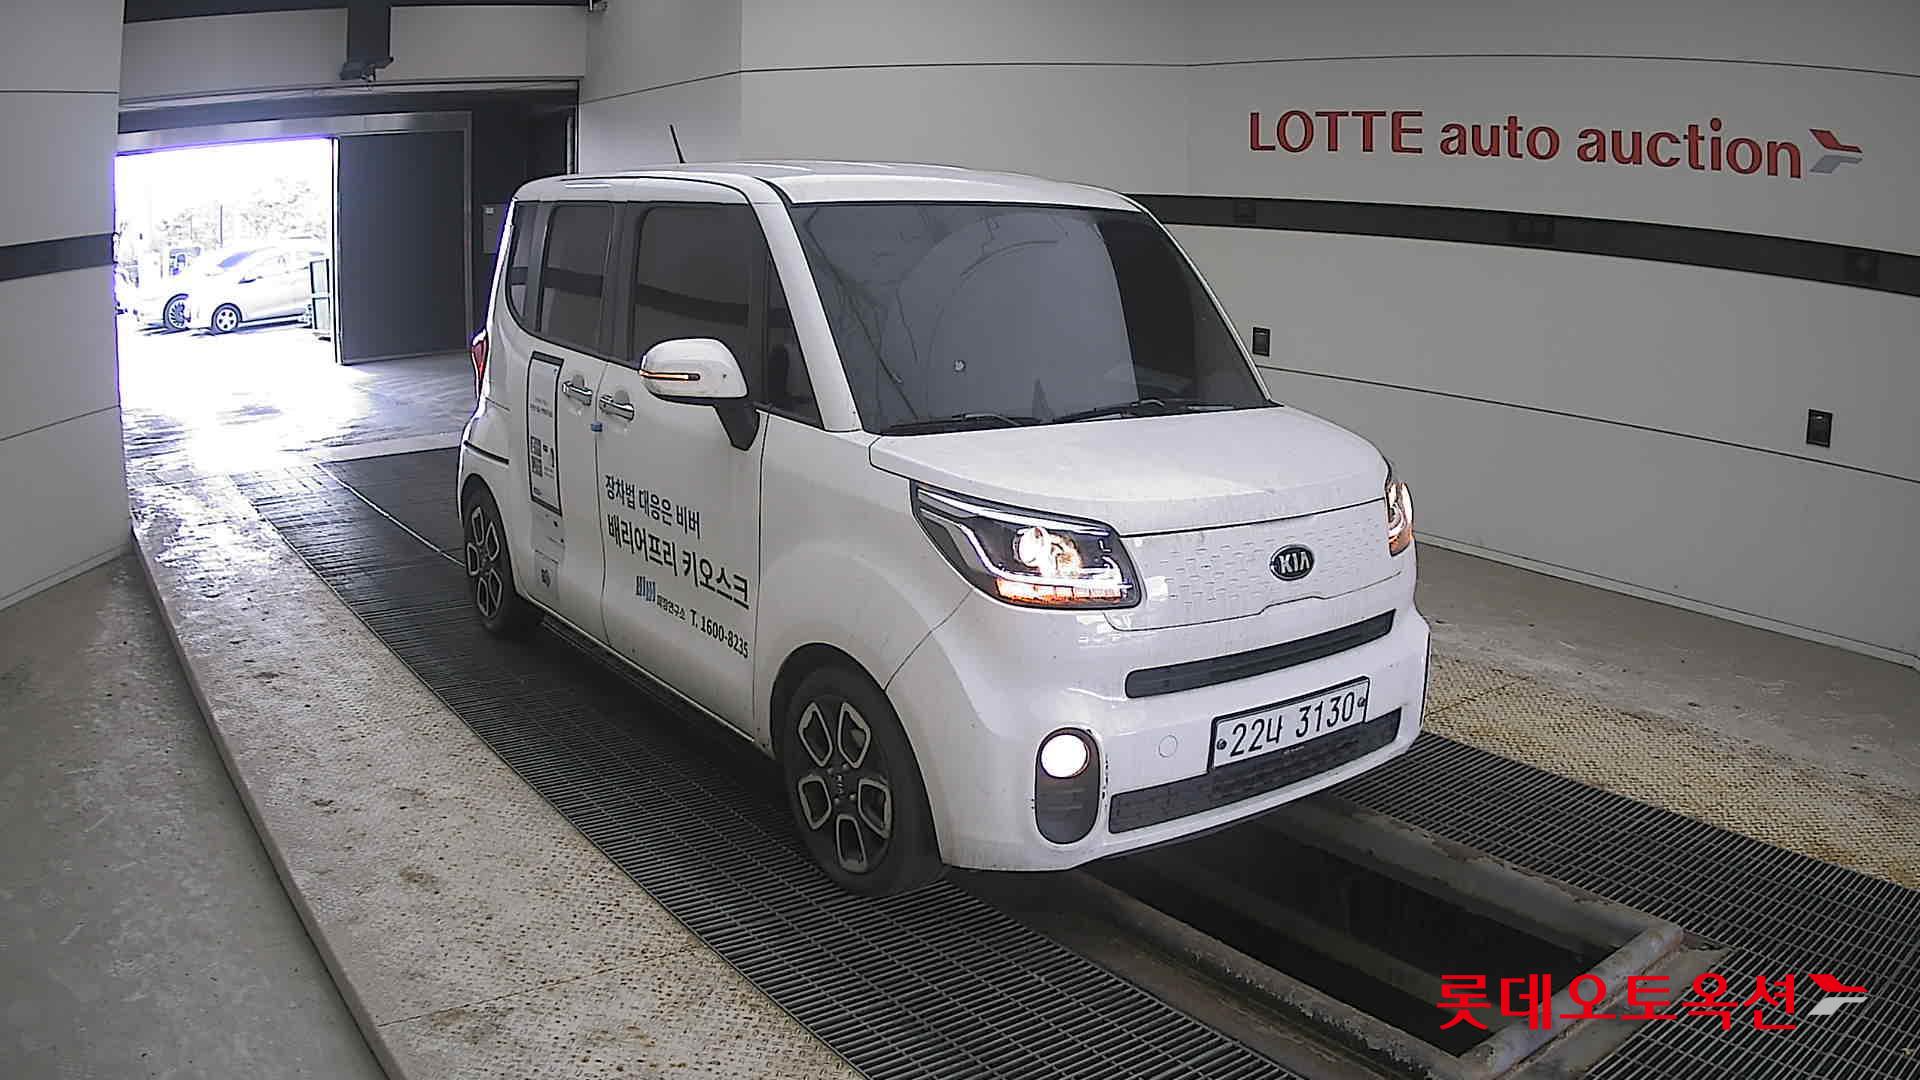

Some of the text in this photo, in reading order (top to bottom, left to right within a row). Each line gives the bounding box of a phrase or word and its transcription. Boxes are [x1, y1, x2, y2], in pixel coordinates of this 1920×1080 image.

[1249, 110, 1802, 179] LOTTE auto auction
[605, 474, 701, 540] 장차법 대응은 비버
[607, 513, 678, 577] 배리어프리
[682, 550, 750, 610] 키오스크
[1279, 551, 1311, 574] KIA
[700, 615, 749, 659] 1600-8235
[1295, 692, 1355, 738] 3130
